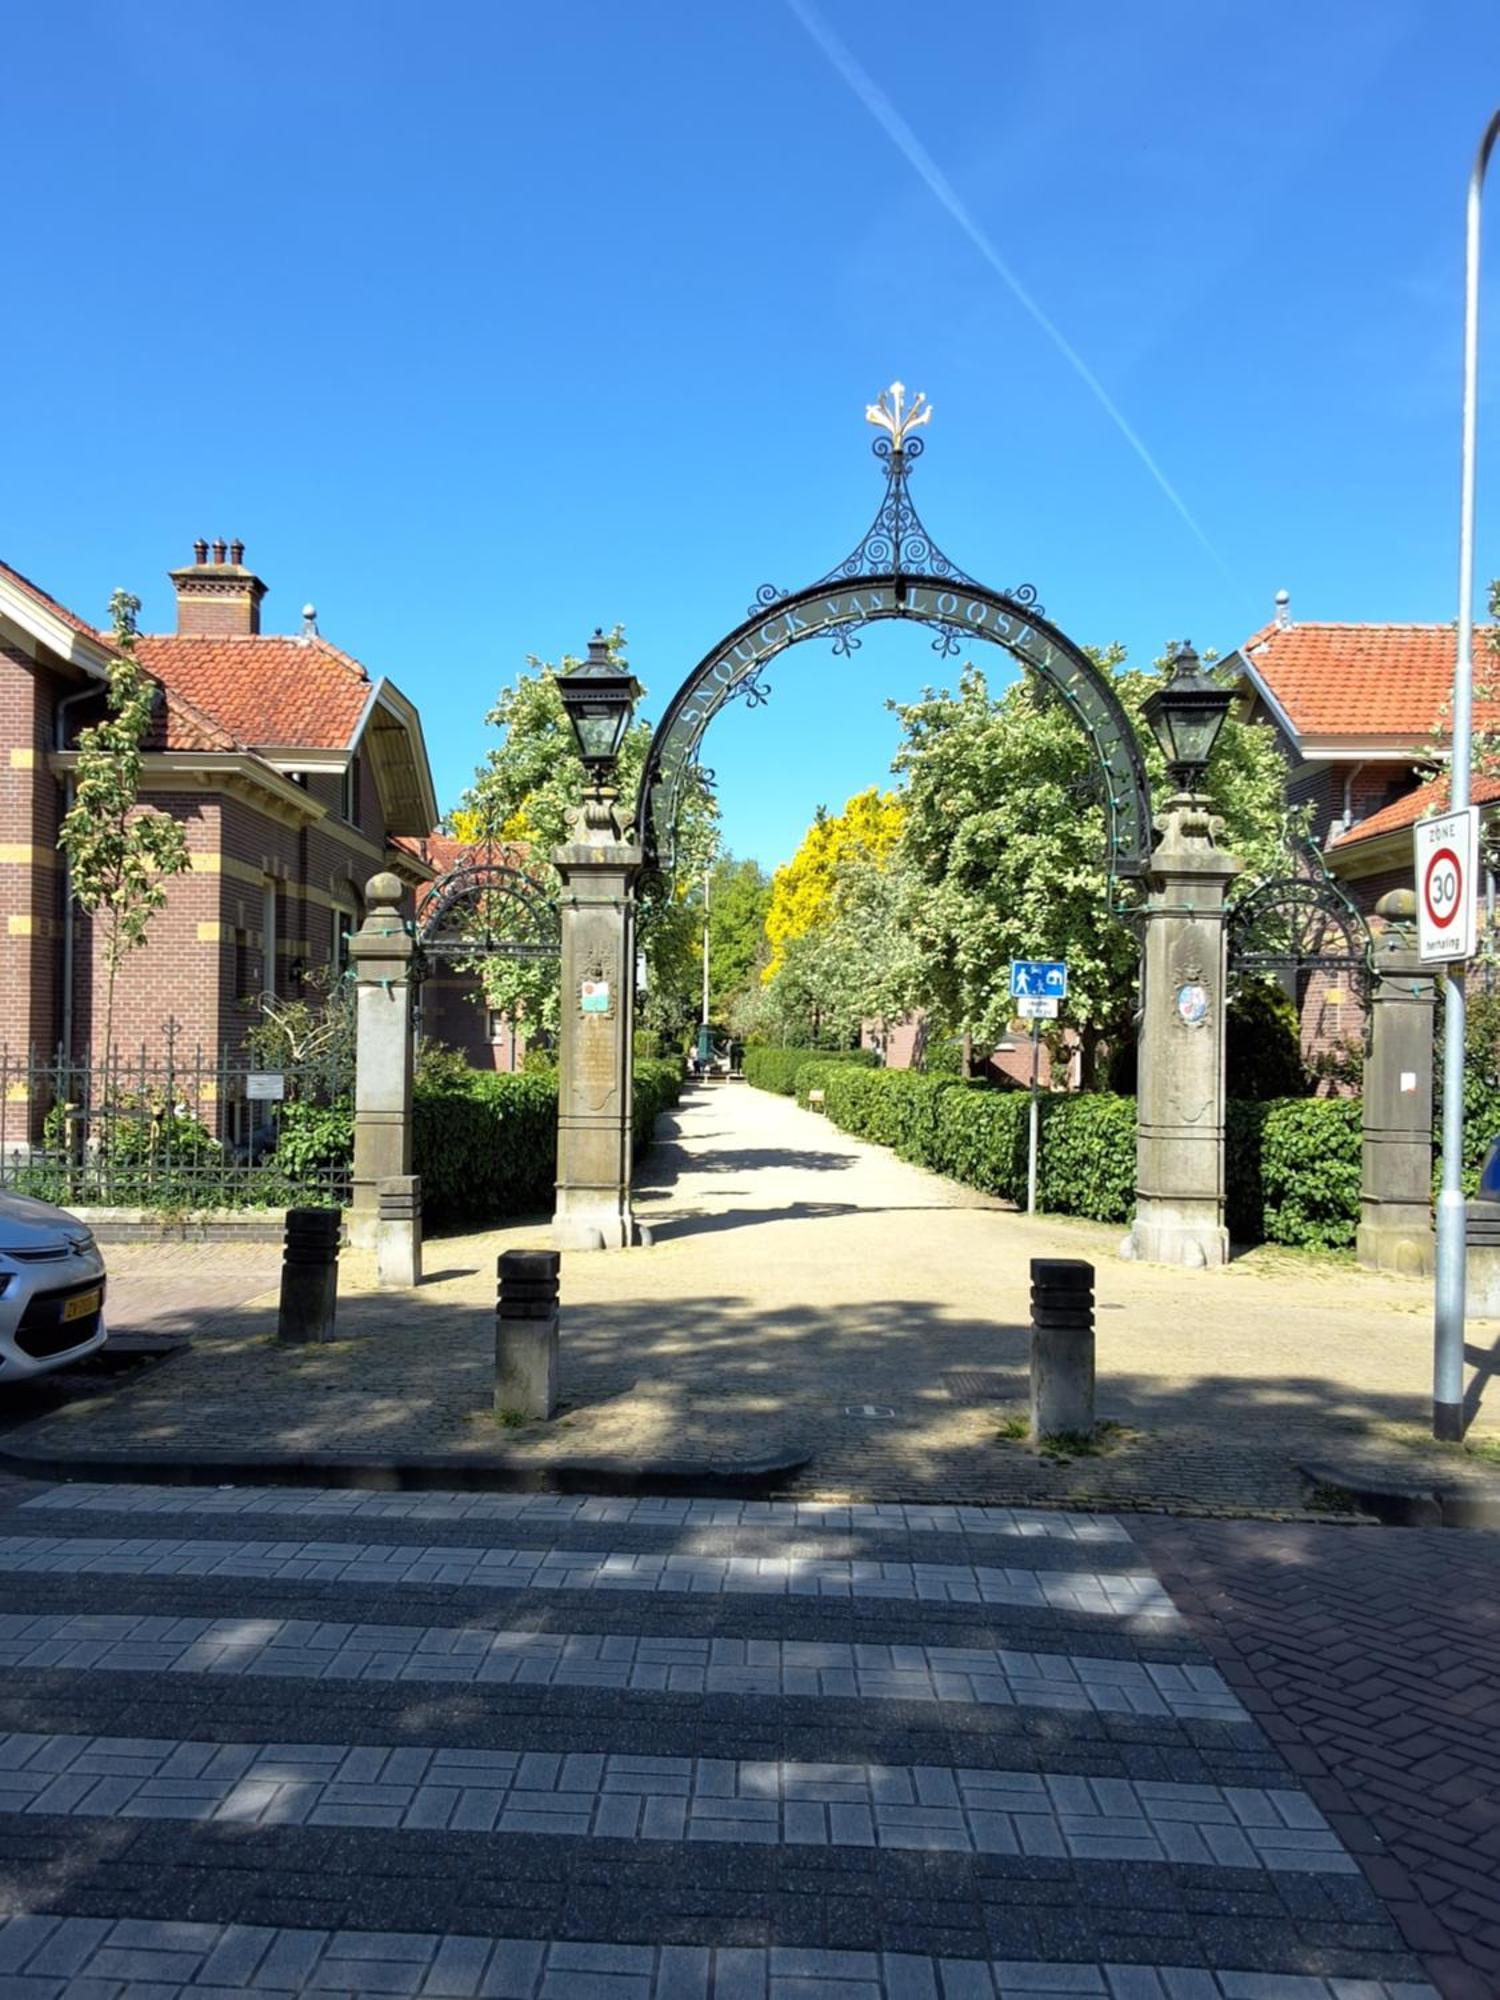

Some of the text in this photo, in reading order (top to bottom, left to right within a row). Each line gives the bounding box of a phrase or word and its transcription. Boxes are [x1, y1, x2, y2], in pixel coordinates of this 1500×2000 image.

[679, 608, 807, 726] SNOUCK
[827, 591, 884, 617] VAN
[1429, 824, 1456, 842] ZONE
[1432, 873, 1455, 904] 30
